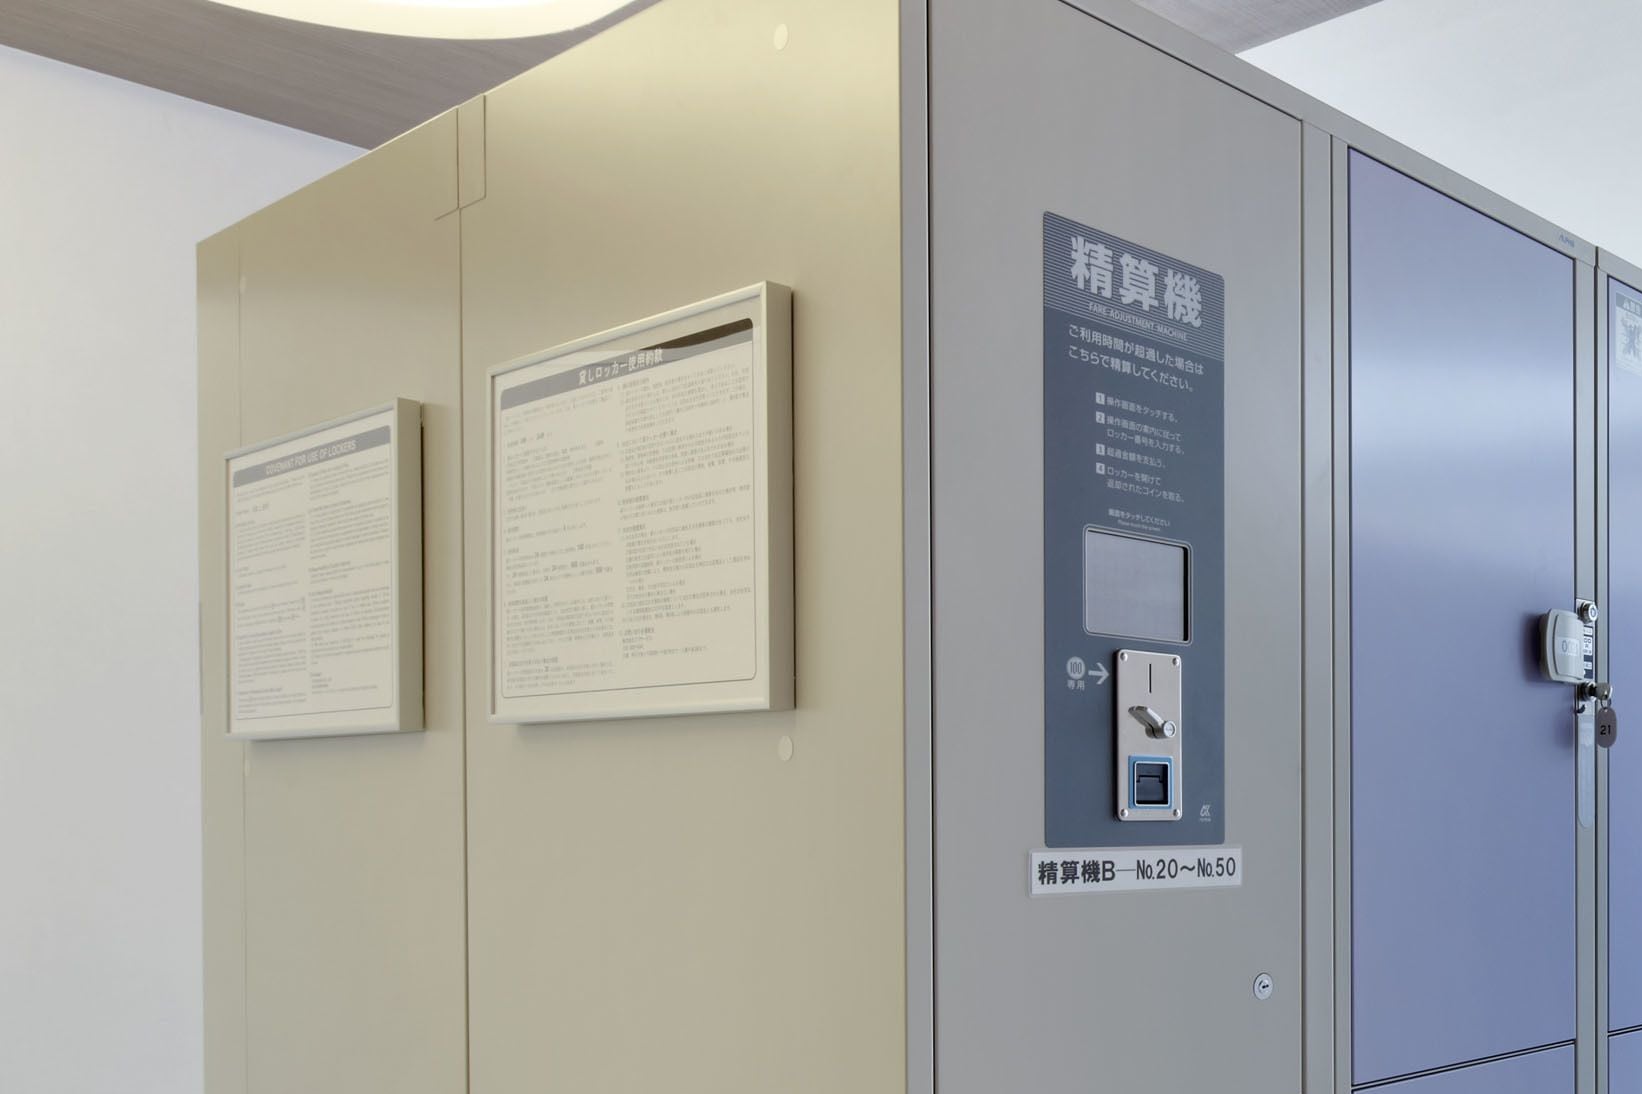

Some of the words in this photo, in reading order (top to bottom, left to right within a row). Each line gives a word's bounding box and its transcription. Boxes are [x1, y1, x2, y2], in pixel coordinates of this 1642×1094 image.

[1071, 235, 1202, 328] 精算機
[1088, 302, 1109, 317] FARE
[1110, 307, 1154, 332] ADJUSTMENT
[1155, 323, 1187, 342] MACHINE
[1069, 324, 1204, 376] ご利用時間が超過した場合は
[1069, 345, 1194, 392] こちらで精算してください。
[1599, 724, 1611, 736] 21
